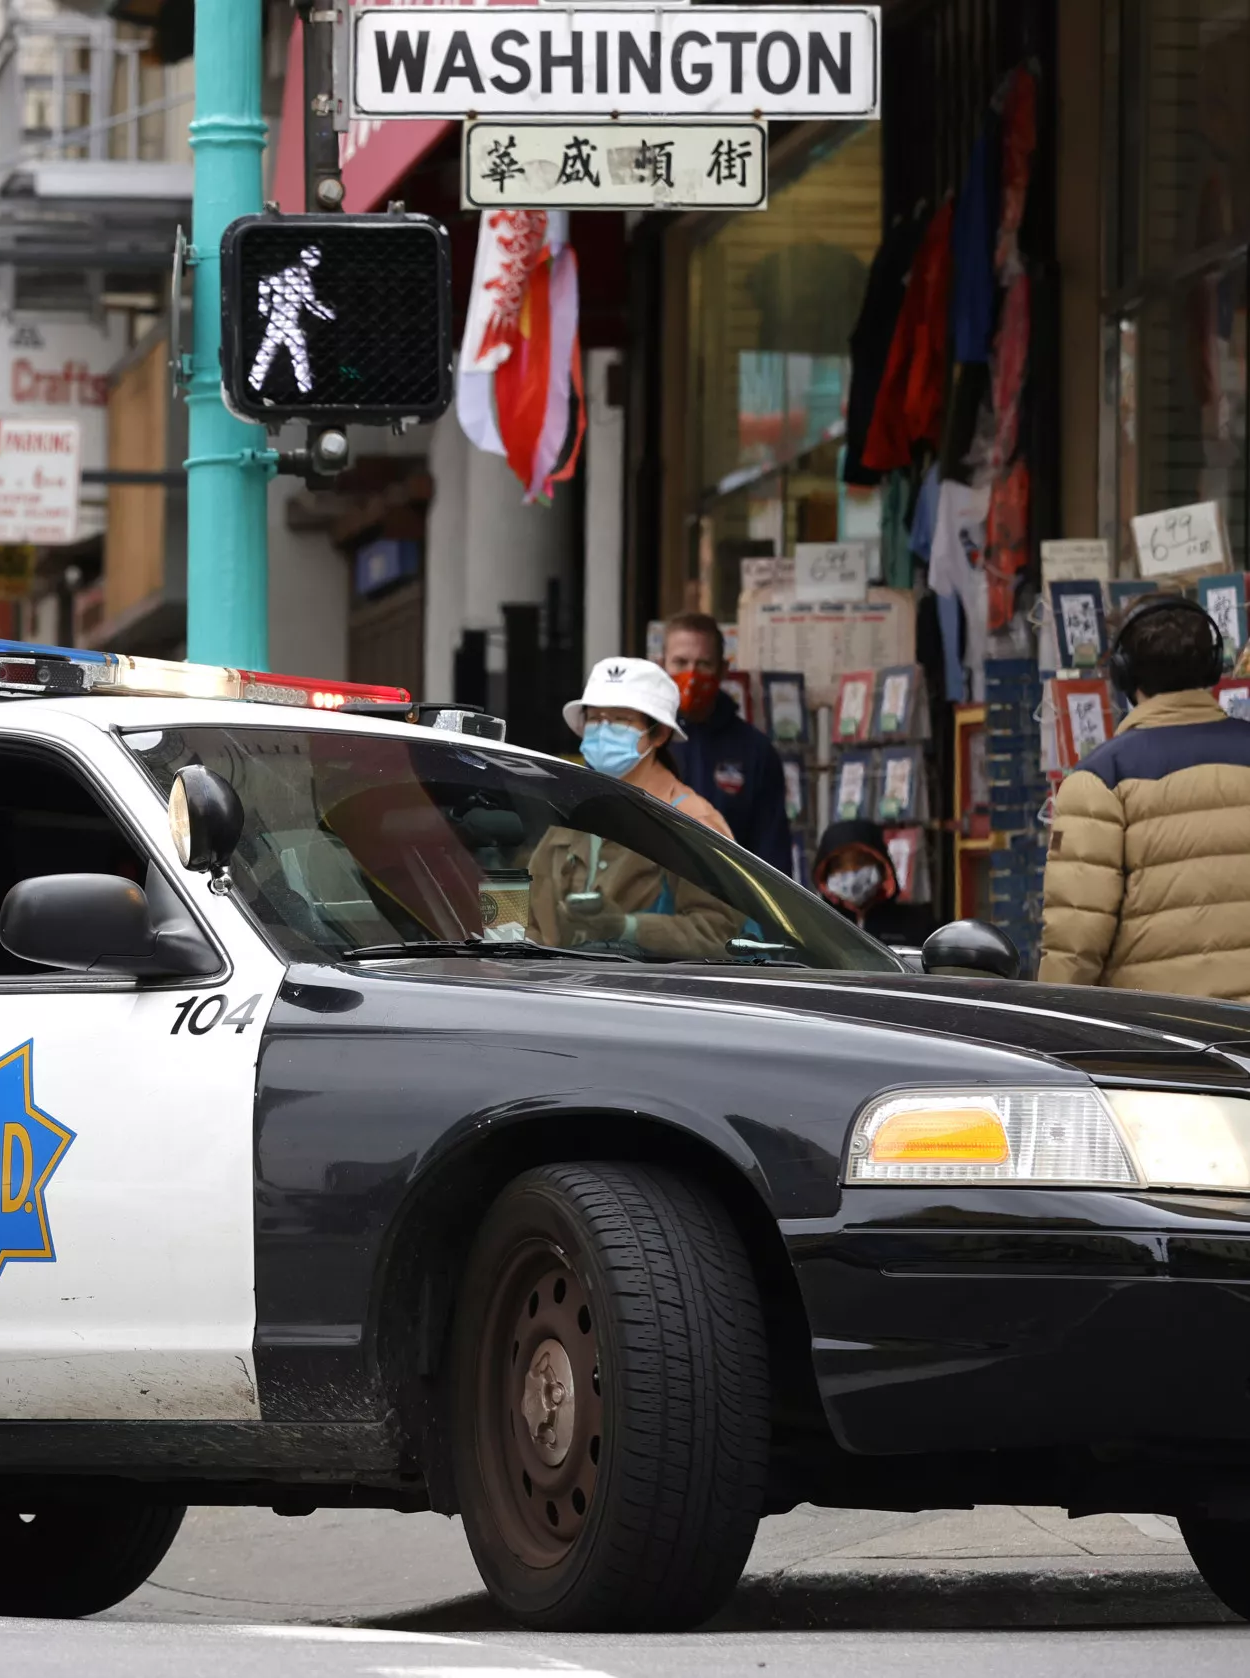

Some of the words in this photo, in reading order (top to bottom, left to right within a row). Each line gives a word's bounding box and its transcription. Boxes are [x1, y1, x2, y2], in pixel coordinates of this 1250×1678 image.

[374, 29, 852, 95] WASHINGTON
[480, 135, 752, 193] 華盛頓街
[5, 431, 71, 453] PARKING
[170, 993, 263, 1036] 104
